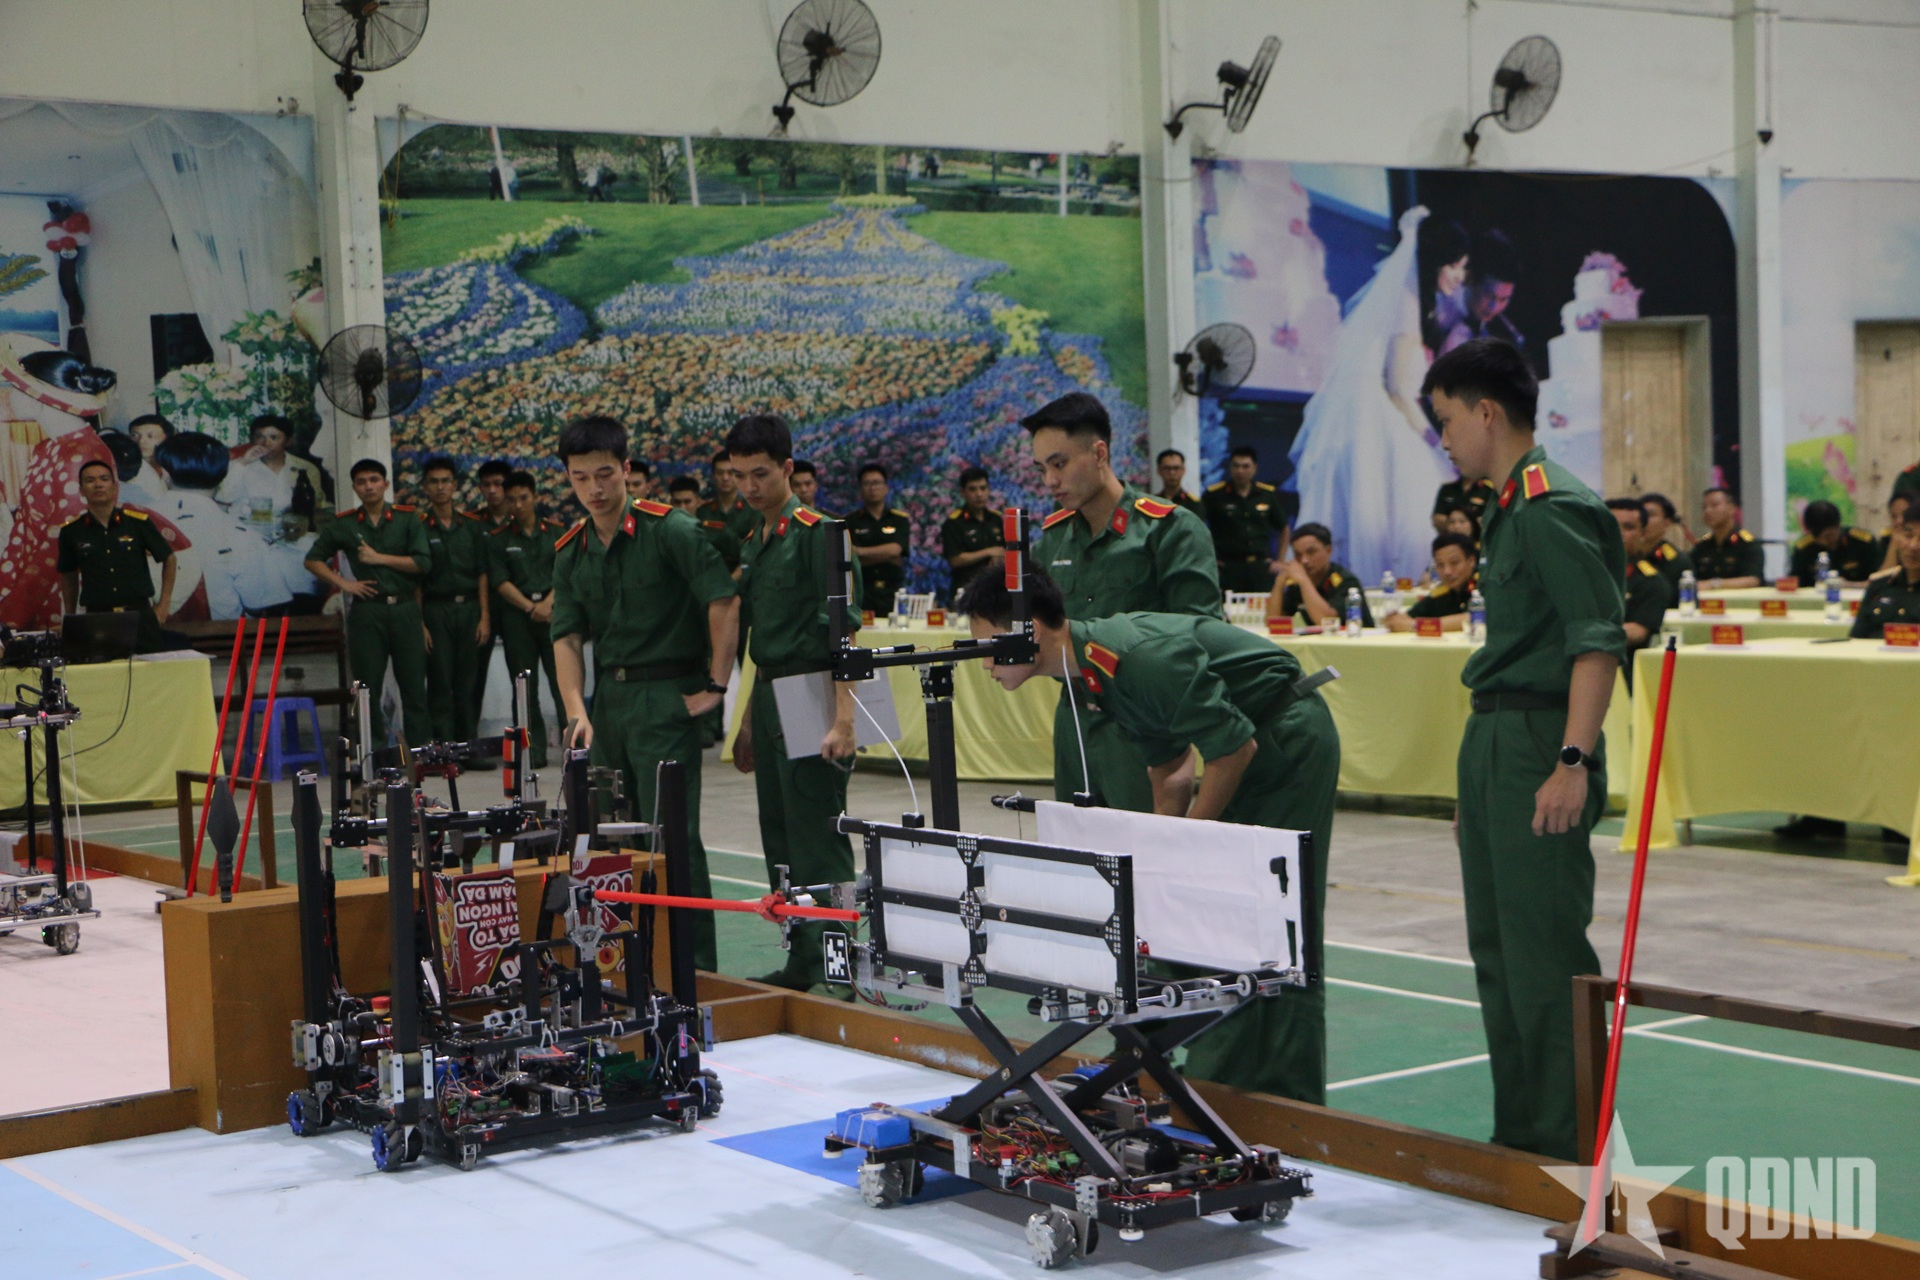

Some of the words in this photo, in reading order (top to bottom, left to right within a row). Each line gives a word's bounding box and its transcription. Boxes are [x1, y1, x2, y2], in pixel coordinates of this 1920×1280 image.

[464, 887, 486, 904] ĐÀ
[458, 902, 502, 922] NGON
[498, 915, 513, 924] NAY
[475, 930, 497, 945] TO
